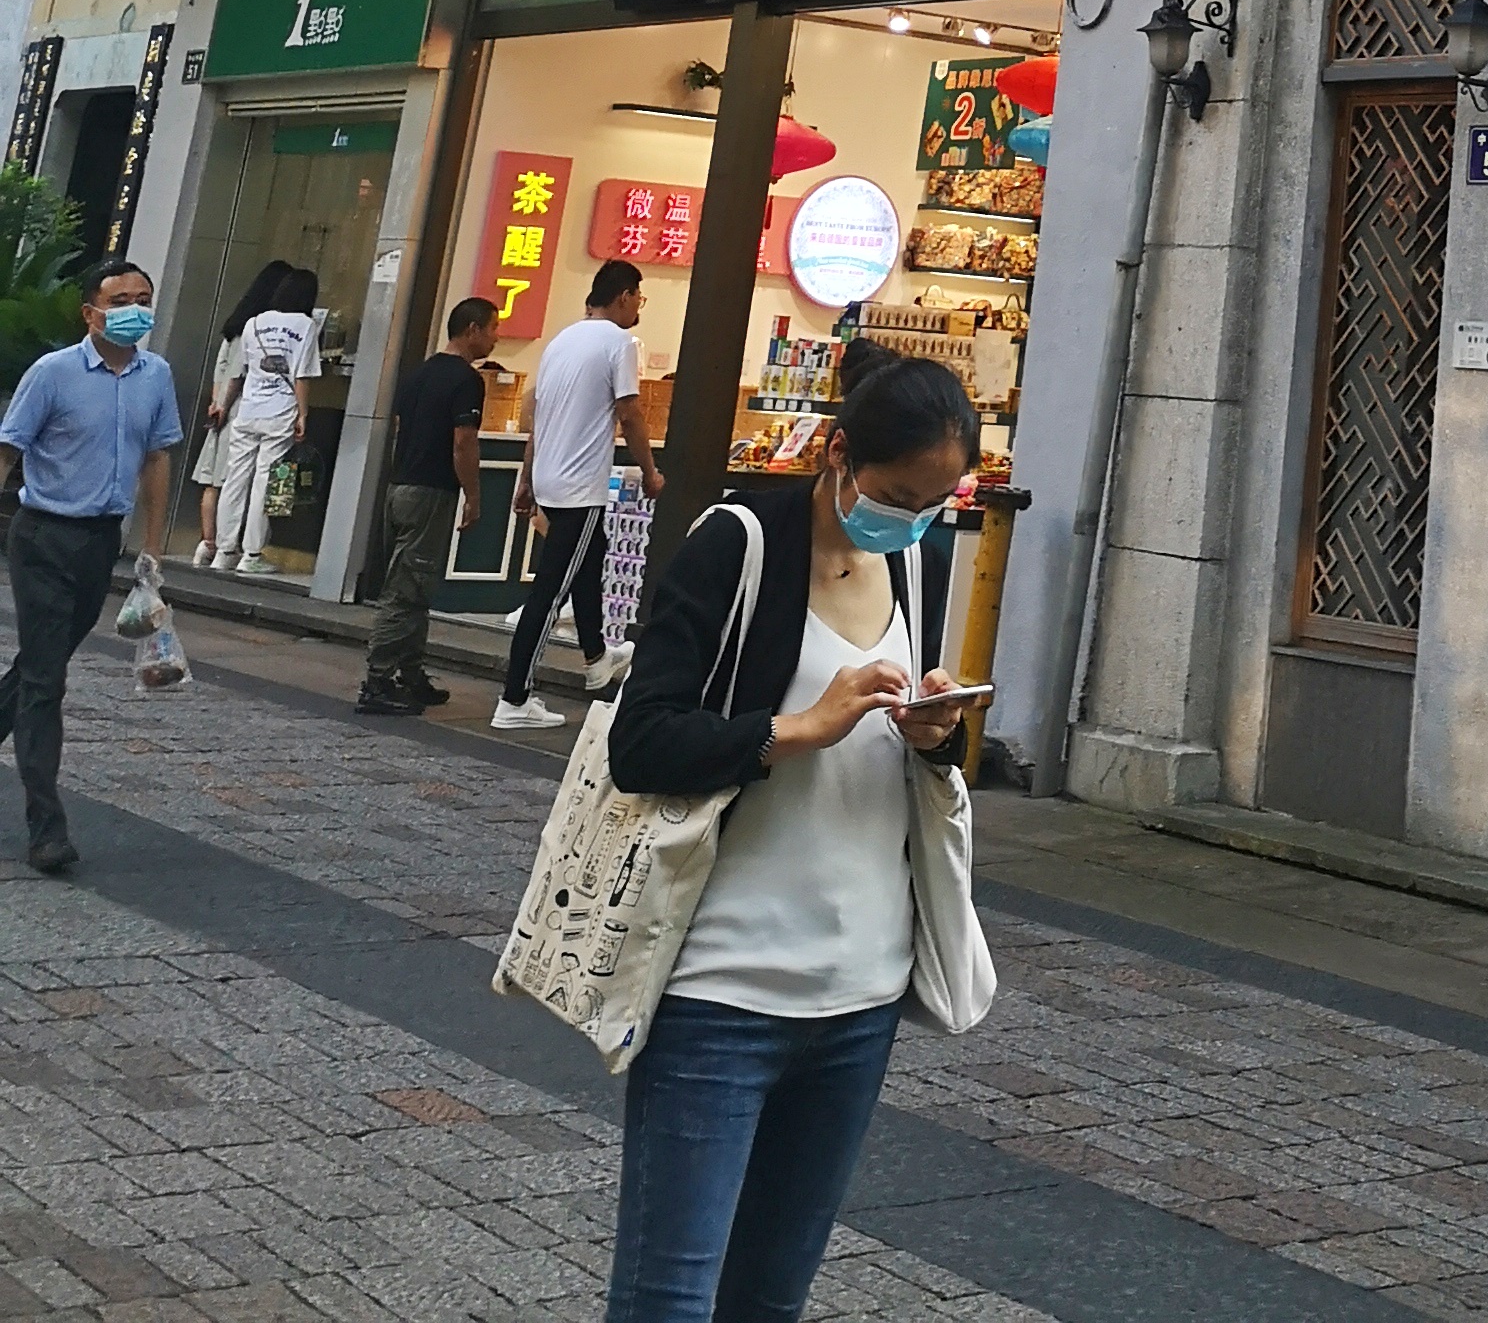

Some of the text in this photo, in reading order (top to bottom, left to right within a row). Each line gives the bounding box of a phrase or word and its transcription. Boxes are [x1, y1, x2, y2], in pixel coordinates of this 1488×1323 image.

[626, 188, 691, 223] 微温
[496, 170, 555, 319] 茶醒了
[620, 224, 689, 258] 芬芳
